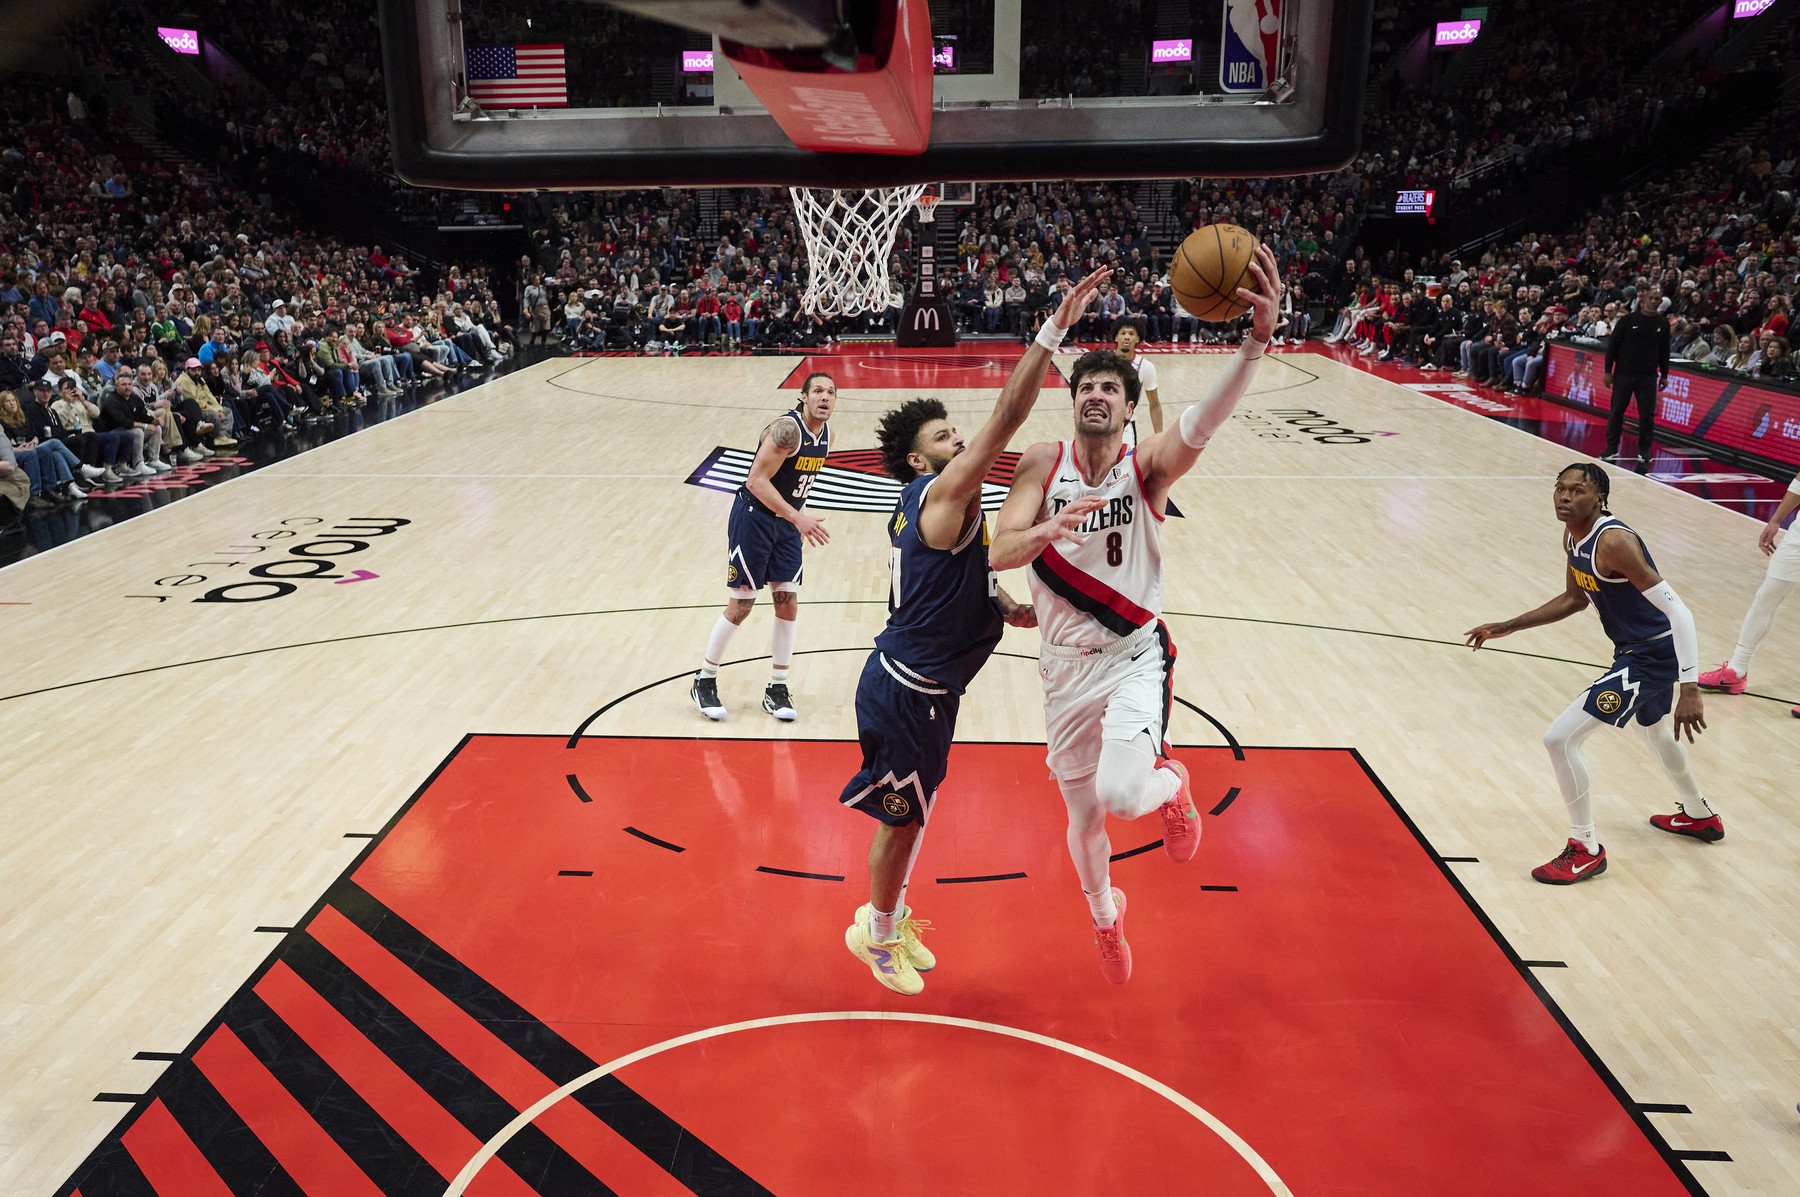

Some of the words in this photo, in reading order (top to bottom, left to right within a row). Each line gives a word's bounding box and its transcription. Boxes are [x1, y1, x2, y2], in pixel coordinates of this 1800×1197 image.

[685, 54, 713, 68] mod
[1154, 42, 1190, 58] moda
[1228, 61, 1255, 84] NBA
[1402, 192, 1424, 203] BLAZERS
[1661, 397, 1693, 426] TODAY
[1266, 409, 1374, 444] moda
[1783, 418, 1800, 440] tic
[795, 456, 825, 472] DENVE
[792, 474, 816, 499] 32
[1053, 495, 1133, 533] BZERS
[191, 517, 412, 603] moda
[1106, 531, 1123, 568] 8
